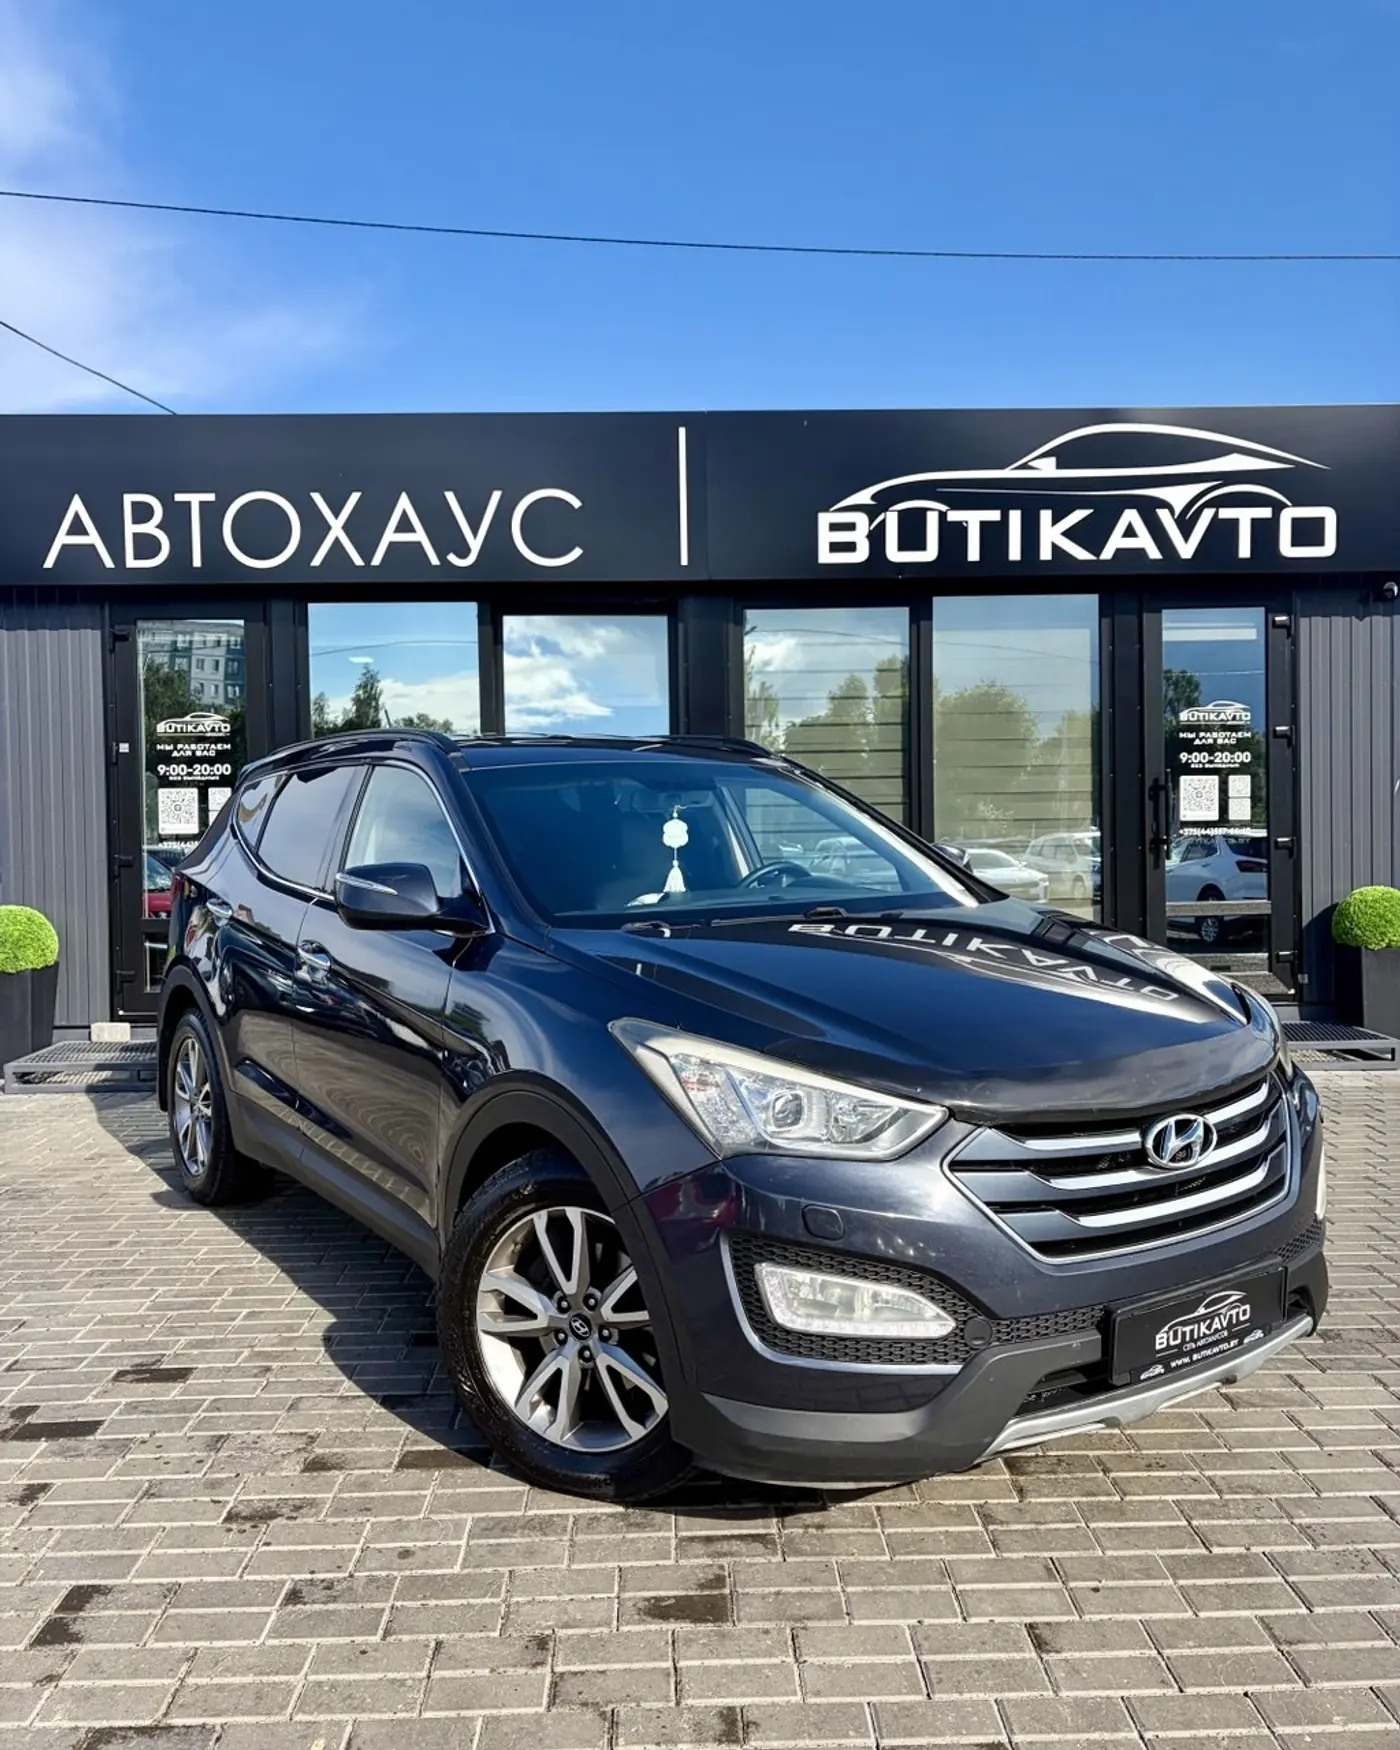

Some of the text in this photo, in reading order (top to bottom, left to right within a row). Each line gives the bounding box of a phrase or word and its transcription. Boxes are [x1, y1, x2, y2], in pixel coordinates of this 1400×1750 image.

[43, 488, 585, 569] АВТОХАУС
[817, 506, 1338, 564] BUTIKAVTO
[1179, 711, 1251, 721] BUTIKAVTO
[156, 723, 231, 733] BUTIKAVTO
[156, 743, 231, 751] МЫ РАБОТАЕМ
[1179, 751, 1251, 764] 9:00-20:00
[157, 763, 232, 776] 9:00-20:00
[1155, 1304, 1251, 1350] BUTIKAVTO
